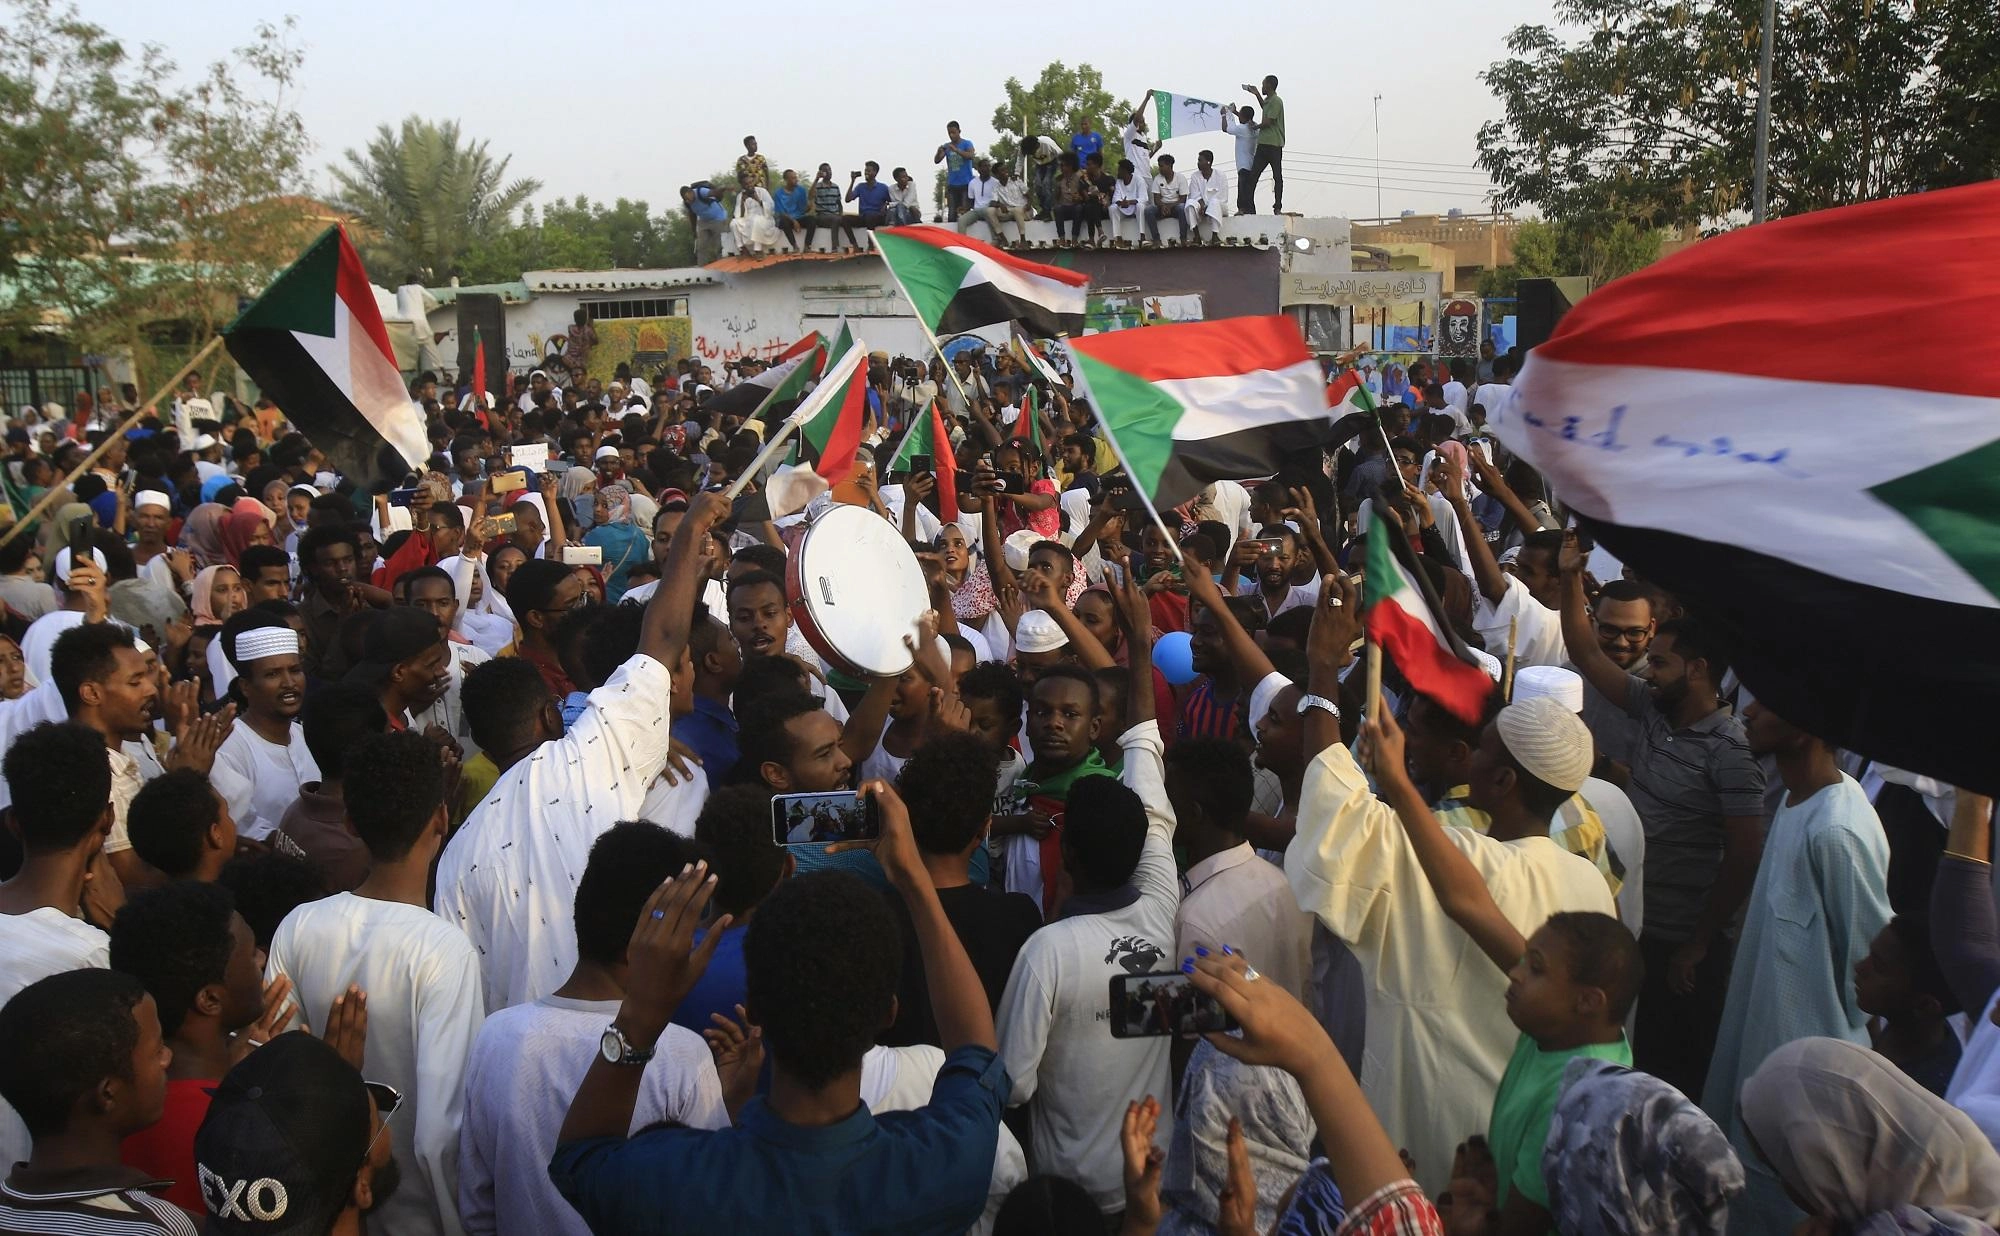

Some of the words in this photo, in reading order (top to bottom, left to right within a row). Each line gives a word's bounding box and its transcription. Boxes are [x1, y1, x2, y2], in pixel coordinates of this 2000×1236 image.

[1359, 281, 1391, 300] بري
[1393, 277, 1427, 300] نادي
[722, 315, 757, 339] مدنية
[198, 1162, 288, 1222] EXO
